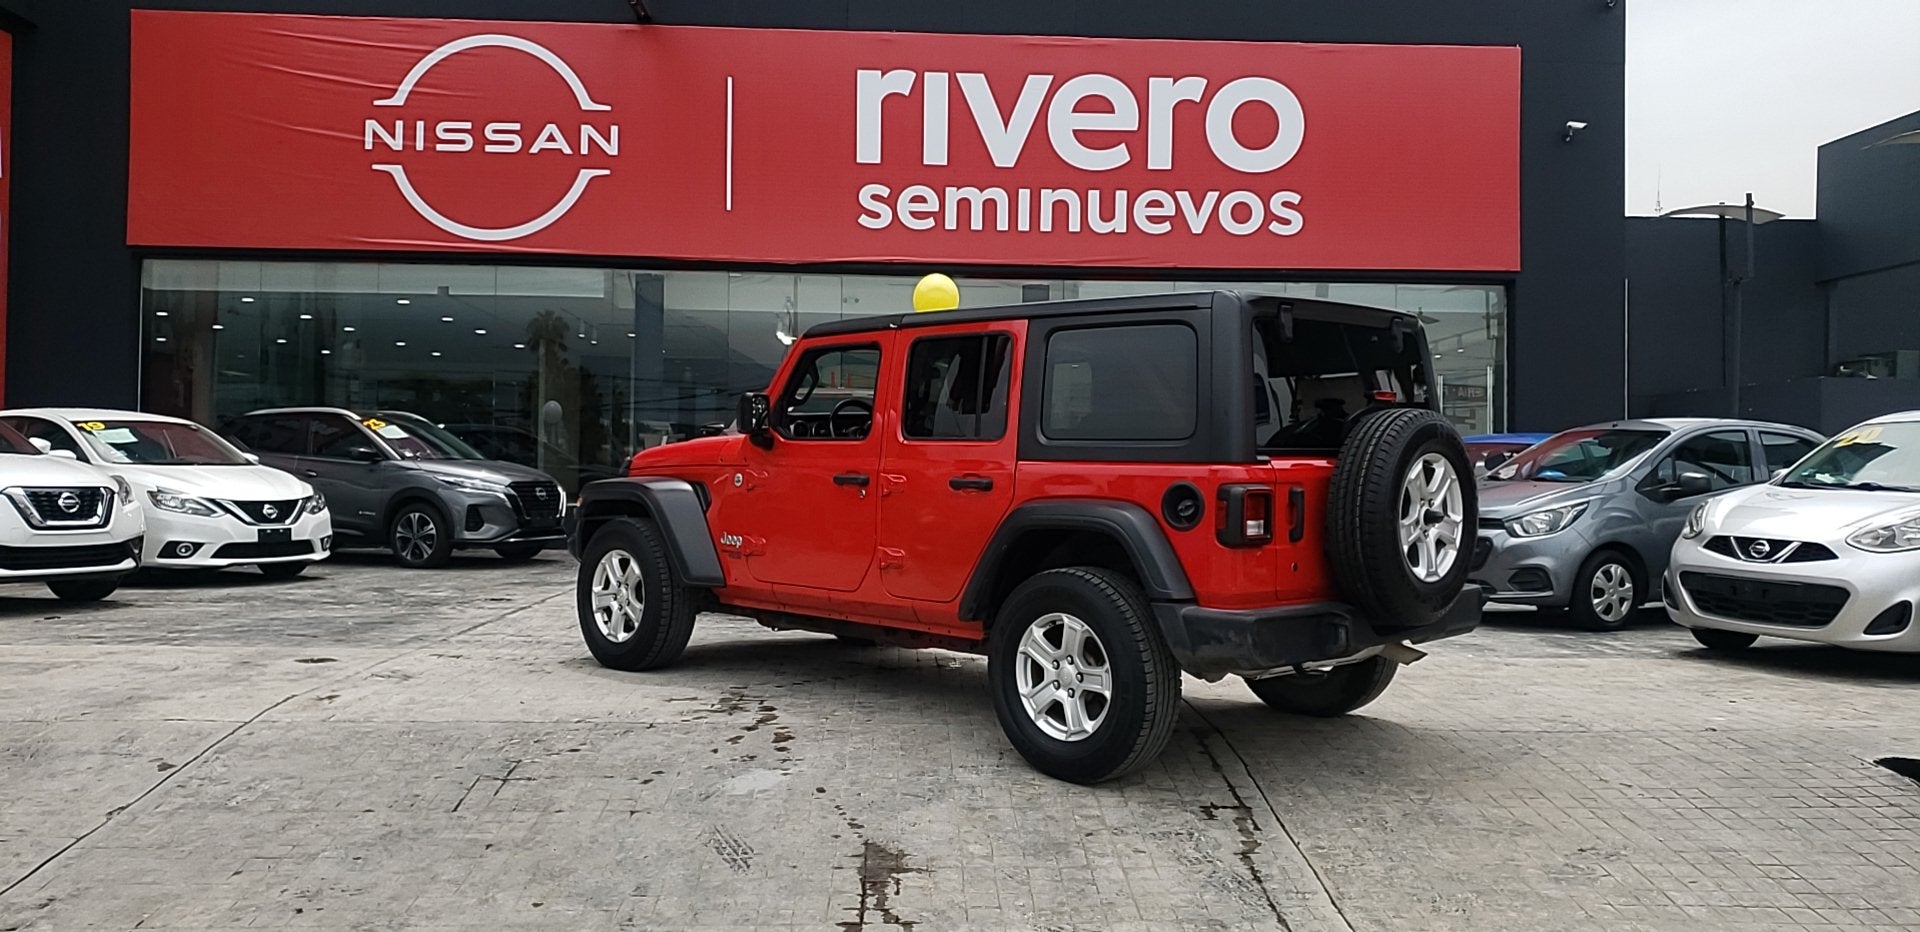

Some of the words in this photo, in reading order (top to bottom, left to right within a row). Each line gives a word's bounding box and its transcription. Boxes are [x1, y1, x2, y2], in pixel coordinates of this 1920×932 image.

[364, 119, 619, 156] NISSAN
[855, 68, 1305, 173] rivero
[856, 183, 1304, 236] seminuevos
[720, 530, 743, 549] Jeep
